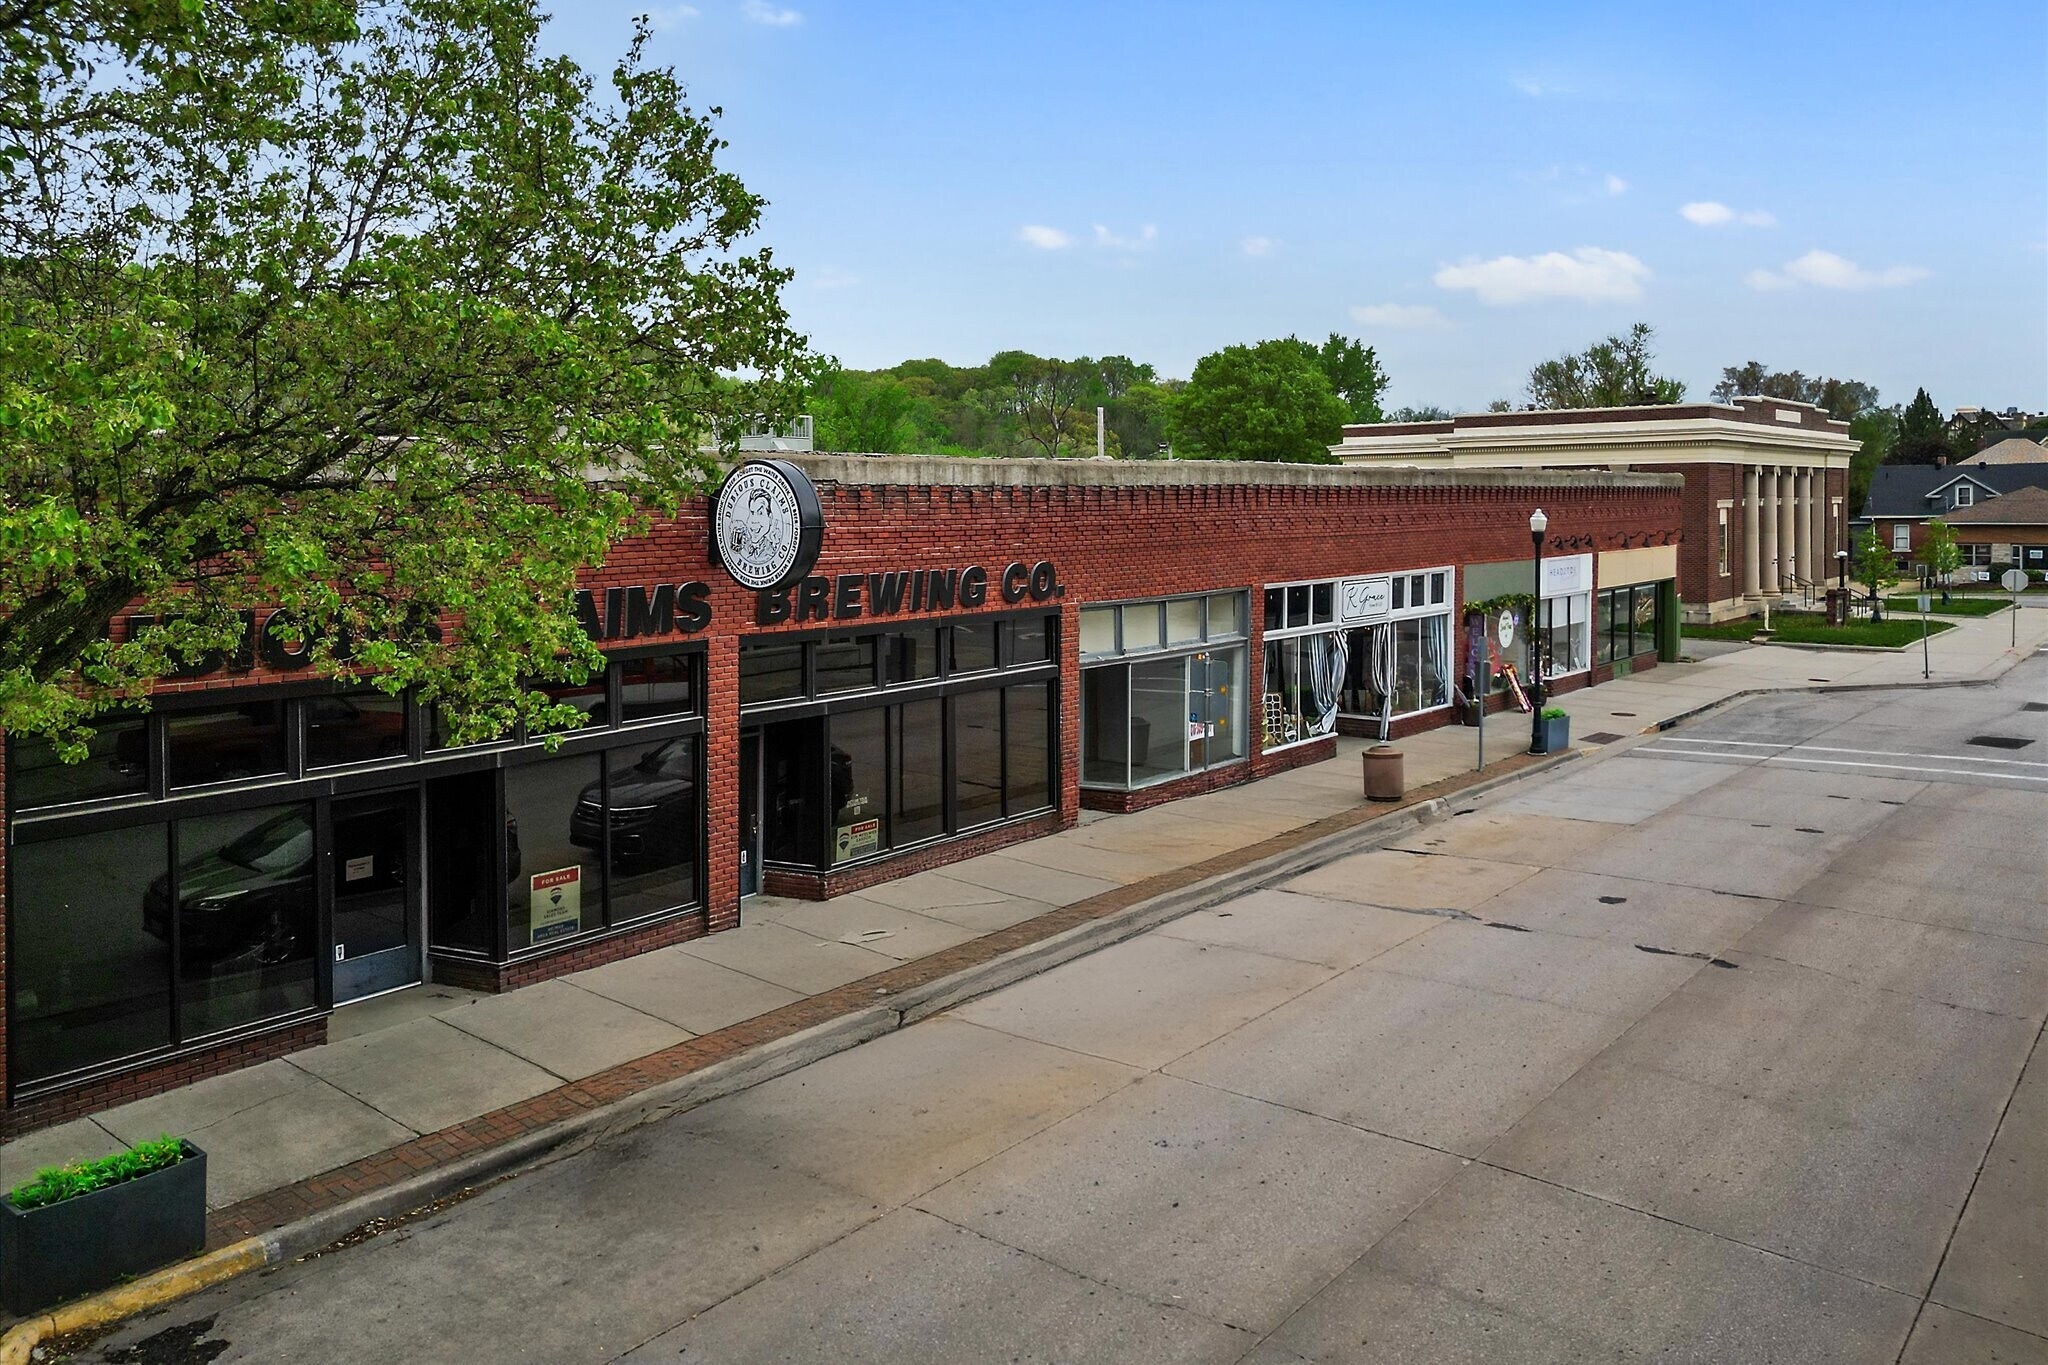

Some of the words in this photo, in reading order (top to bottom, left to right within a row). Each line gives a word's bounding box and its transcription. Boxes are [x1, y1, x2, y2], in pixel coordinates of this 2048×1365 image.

[725, 478, 755, 519] DUBIOUS
[760, 479, 789, 514] CLAIMS
[737, 558, 777, 576] BREWING
[757, 566, 988, 624] BREWING
[1002, 561, 1065, 604] CO.
[555, 874, 571, 882] SALE
